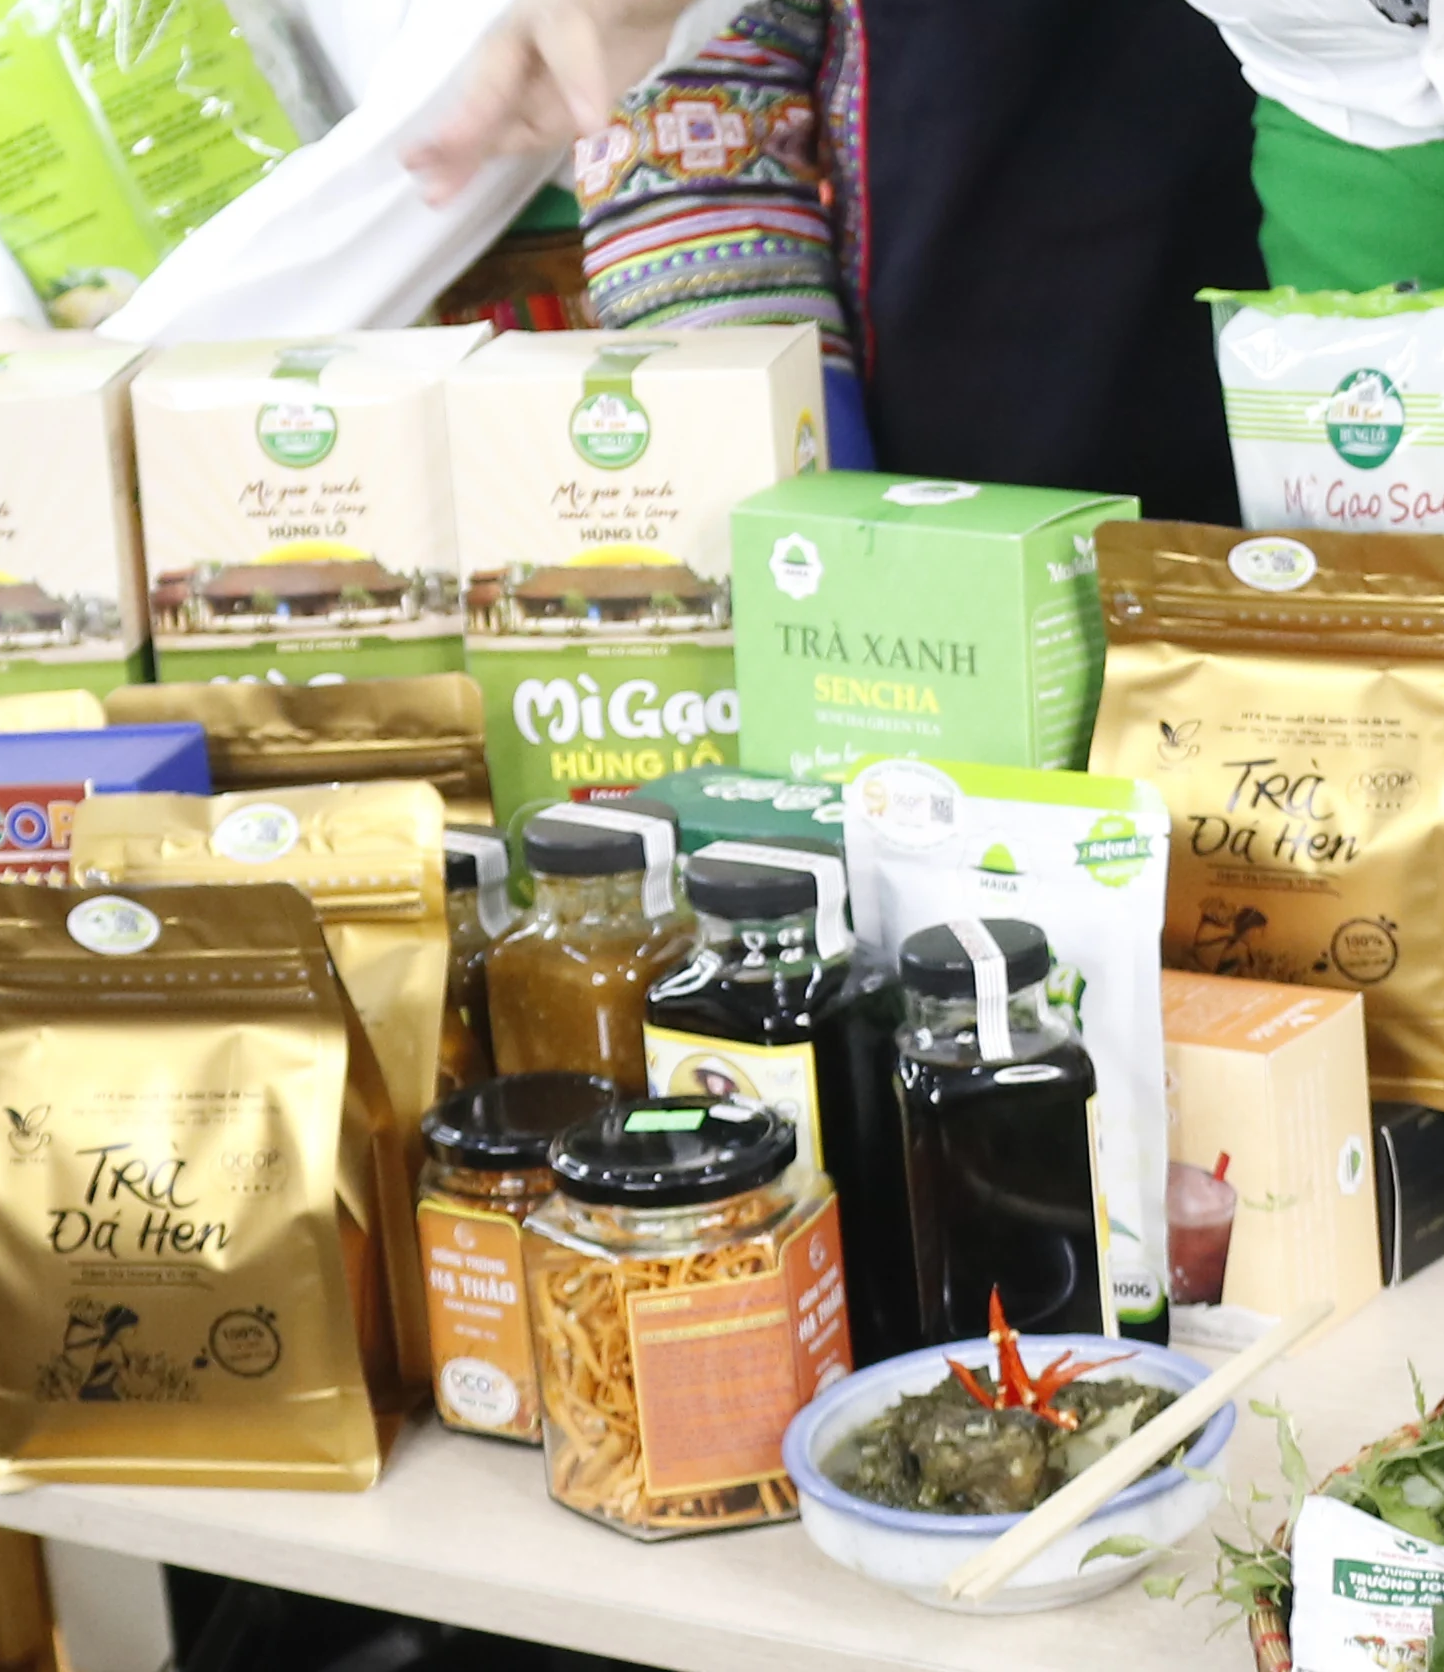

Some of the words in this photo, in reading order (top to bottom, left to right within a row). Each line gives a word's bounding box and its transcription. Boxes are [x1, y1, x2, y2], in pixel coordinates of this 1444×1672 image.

[775, 620, 850, 664] TRÀ
[862, 631, 978, 677] XANH
[814, 673, 941, 715] SENCHA
[551, 744, 664, 780] HÙNG
[1273, 823, 1360, 864] Hen
[46, 1207, 122, 1259] Đá
[138, 1211, 233, 1256] Hen
[459, 1274, 517, 1305] THẢO
[1113, 1280, 1152, 1300] 100G
[1349, 1571, 1417, 1593] TRƯỜNG
